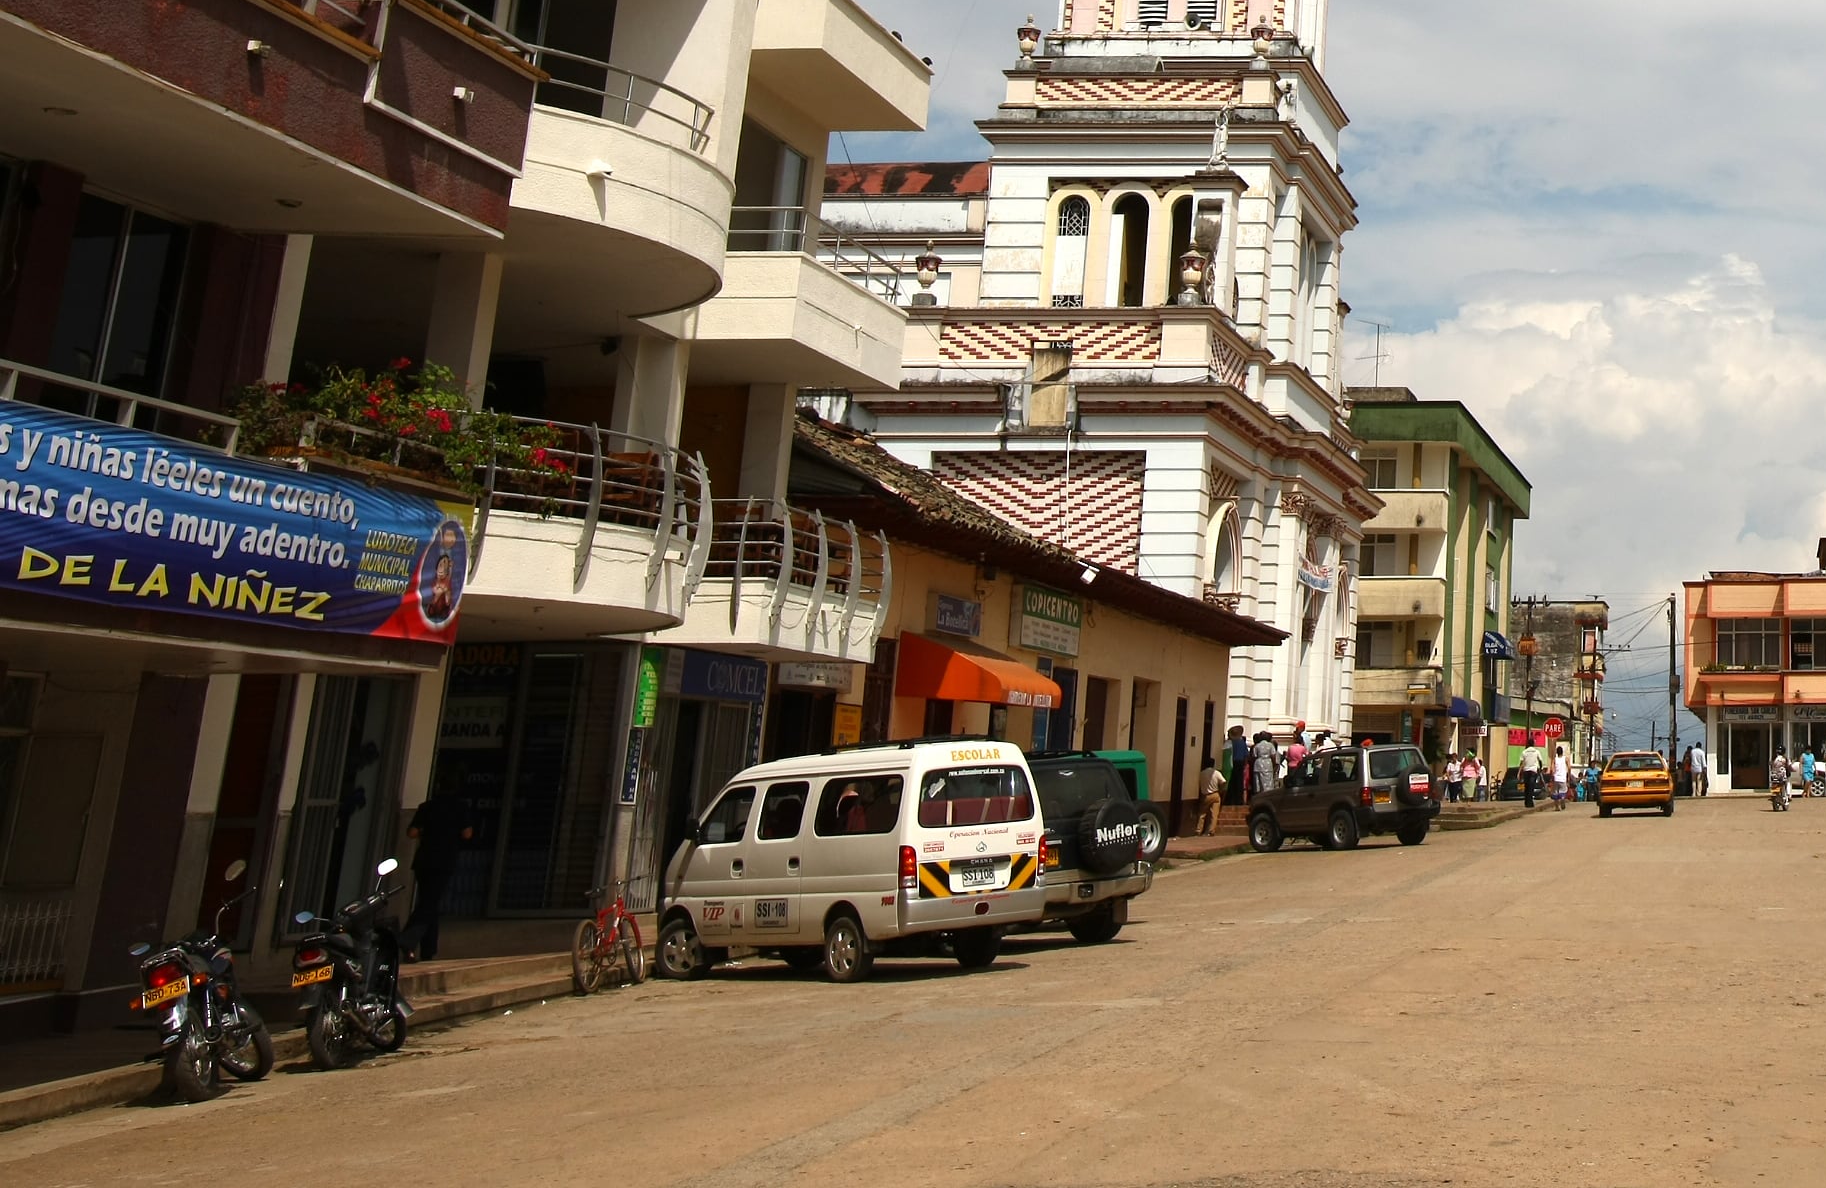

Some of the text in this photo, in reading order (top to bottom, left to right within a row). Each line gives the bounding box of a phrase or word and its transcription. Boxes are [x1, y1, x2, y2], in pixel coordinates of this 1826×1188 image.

[16, 428, 43, 471] y
[47, 430, 137, 480] niñas
[141, 447, 225, 498] léeles
[229, 475, 267, 506] un
[270, 483, 359, 530] cuento,
[66, 486, 164, 535] desde
[170, 512, 237, 560] muy
[239, 523, 350, 569] adentro.
[365, 530, 418, 556] LUDOTECA
[358, 552, 410, 577] MUNICIPAL
[17, 545, 332, 620] DE LA NIÑEZ
[354, 574, 408, 594] CHAPARRITOS
[1026, 591, 1079, 623] COPICENTRO
[707, 661, 761, 696] COMCEL
[1545, 724, 1562, 732] PARE
[951, 748, 1001, 761] ESCOLAR
[1096, 823, 1140, 843] Nuflor
[703, 907, 725, 921] VIP
